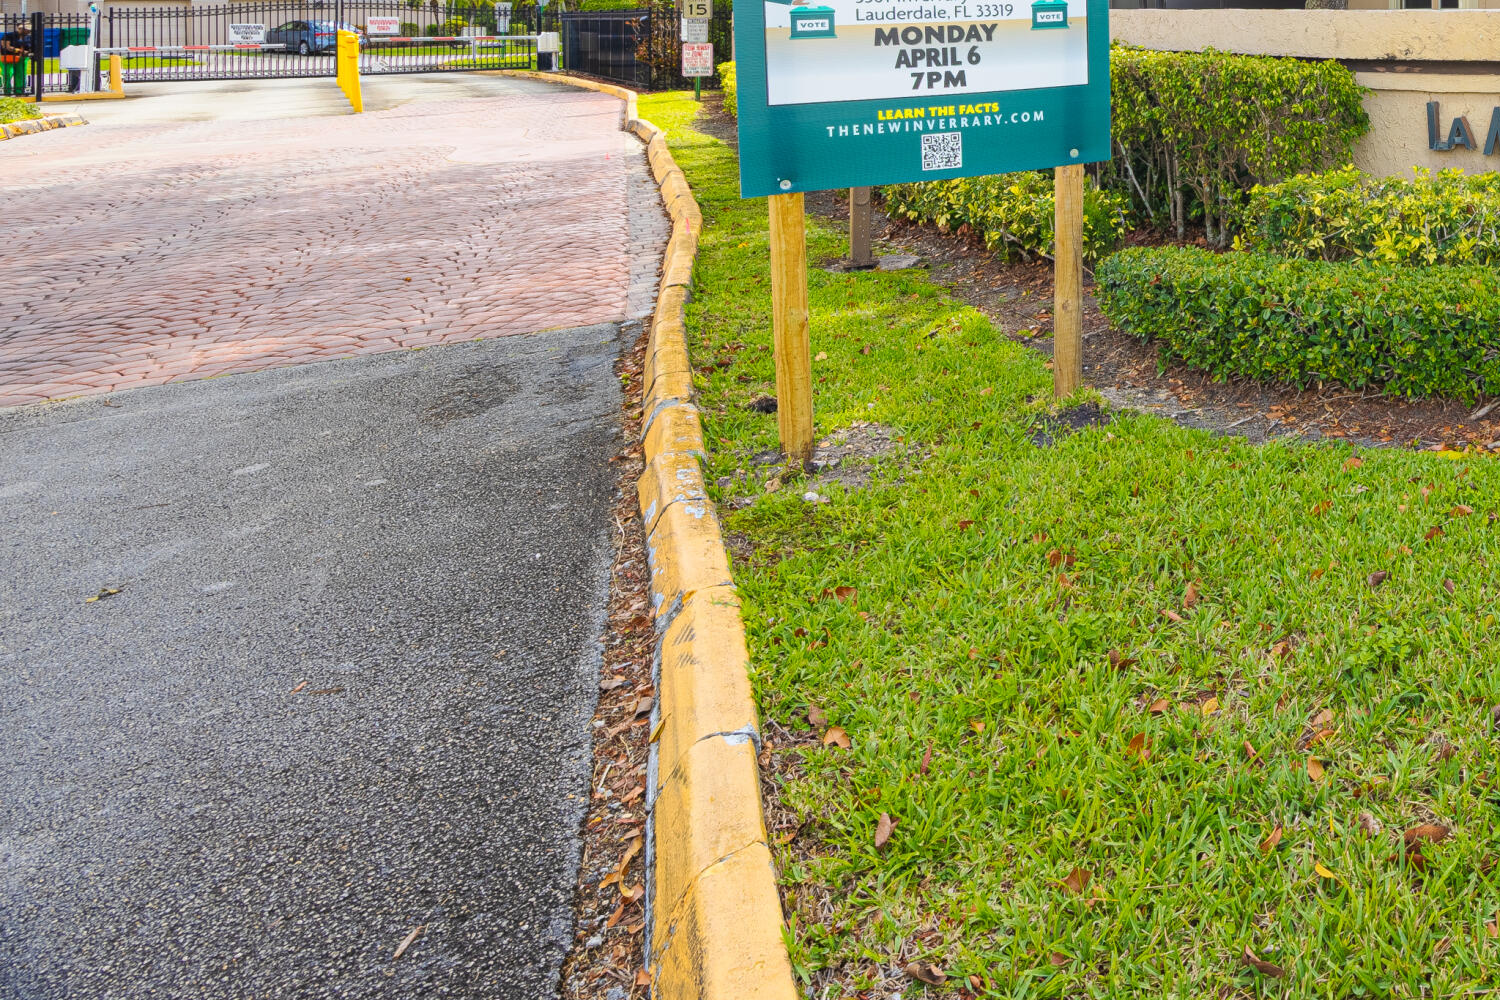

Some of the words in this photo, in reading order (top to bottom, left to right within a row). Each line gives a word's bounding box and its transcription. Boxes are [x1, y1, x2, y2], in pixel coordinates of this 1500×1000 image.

[689, 3, 707, 16] 15
[855, 7, 951, 22] Lauderdale,
[954, 6, 972, 19] FL
[976, 4, 1014, 18] 33319
[874, 23, 998, 46] MONDAY
[894, 47, 962, 69] APRIL
[967, 45, 981, 65] 6
[910, 70, 967, 90] 7PM
[877, 107, 925, 121] LEARN
[928, 105, 955, 118] THE
[958, 102, 1000, 115] FACTS
[826, 110, 1044, 137] THENEWINVERRARY.COM
